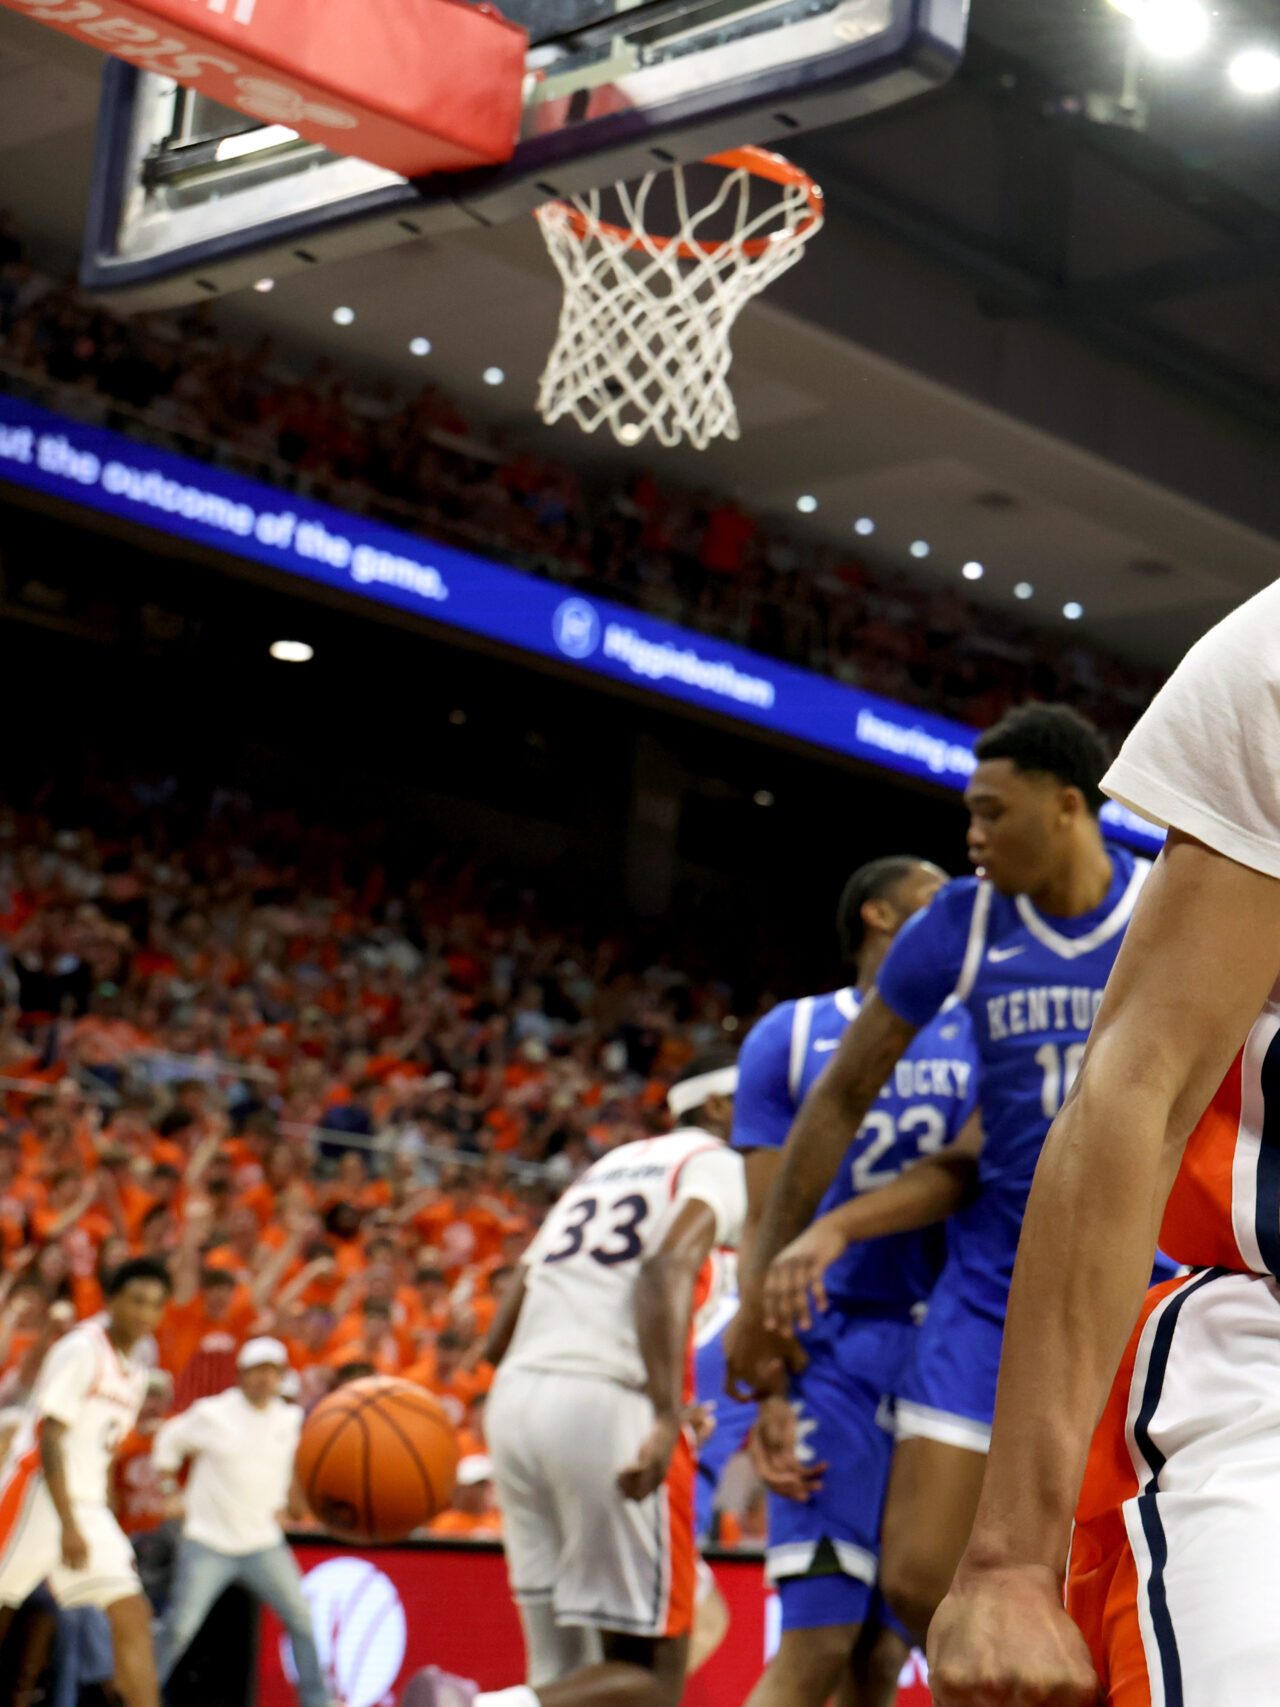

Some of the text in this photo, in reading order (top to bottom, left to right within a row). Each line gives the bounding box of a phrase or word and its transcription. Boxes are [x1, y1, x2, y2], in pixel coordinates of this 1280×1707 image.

[26, 0, 239, 78] Stat
[37, 434, 100, 485] the
[101, 460, 256, 537] outcome
[255, 511, 298, 549] of
[295, 520, 352, 568] the
[986, 986, 1106, 1041] KENTU
[880, 1058, 971, 1099] UCKY
[852, 1105, 945, 1190] 23
[544, 1195, 648, 1265] 33
